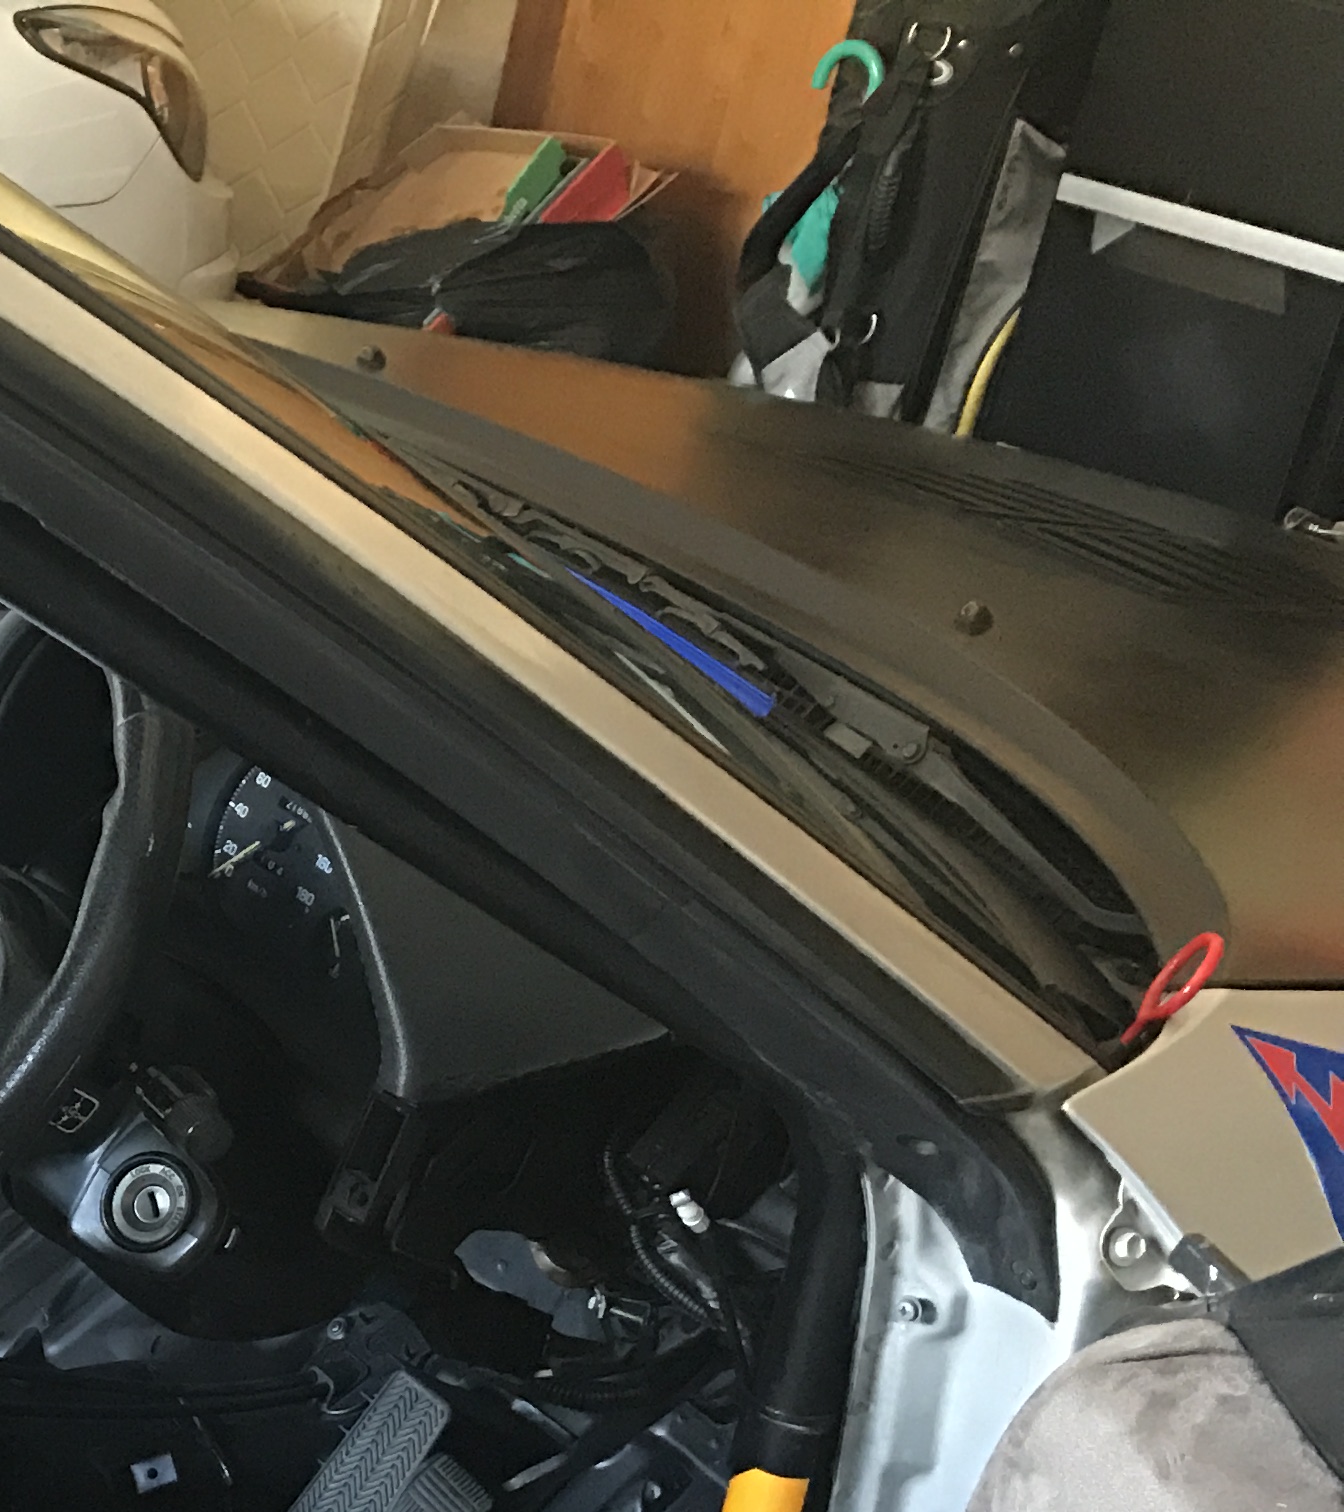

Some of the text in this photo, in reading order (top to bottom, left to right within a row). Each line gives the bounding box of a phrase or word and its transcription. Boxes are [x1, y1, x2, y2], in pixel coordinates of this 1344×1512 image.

[255, 771, 272, 789] 60
[234, 802, 250, 819] 40
[222, 839, 238, 856] 20
[295, 885, 316, 907] 180
[130, 1164, 151, 1179] LOCK
[158, 1165, 175, 1179] ACC
[175, 1185, 185, 1198] ON
